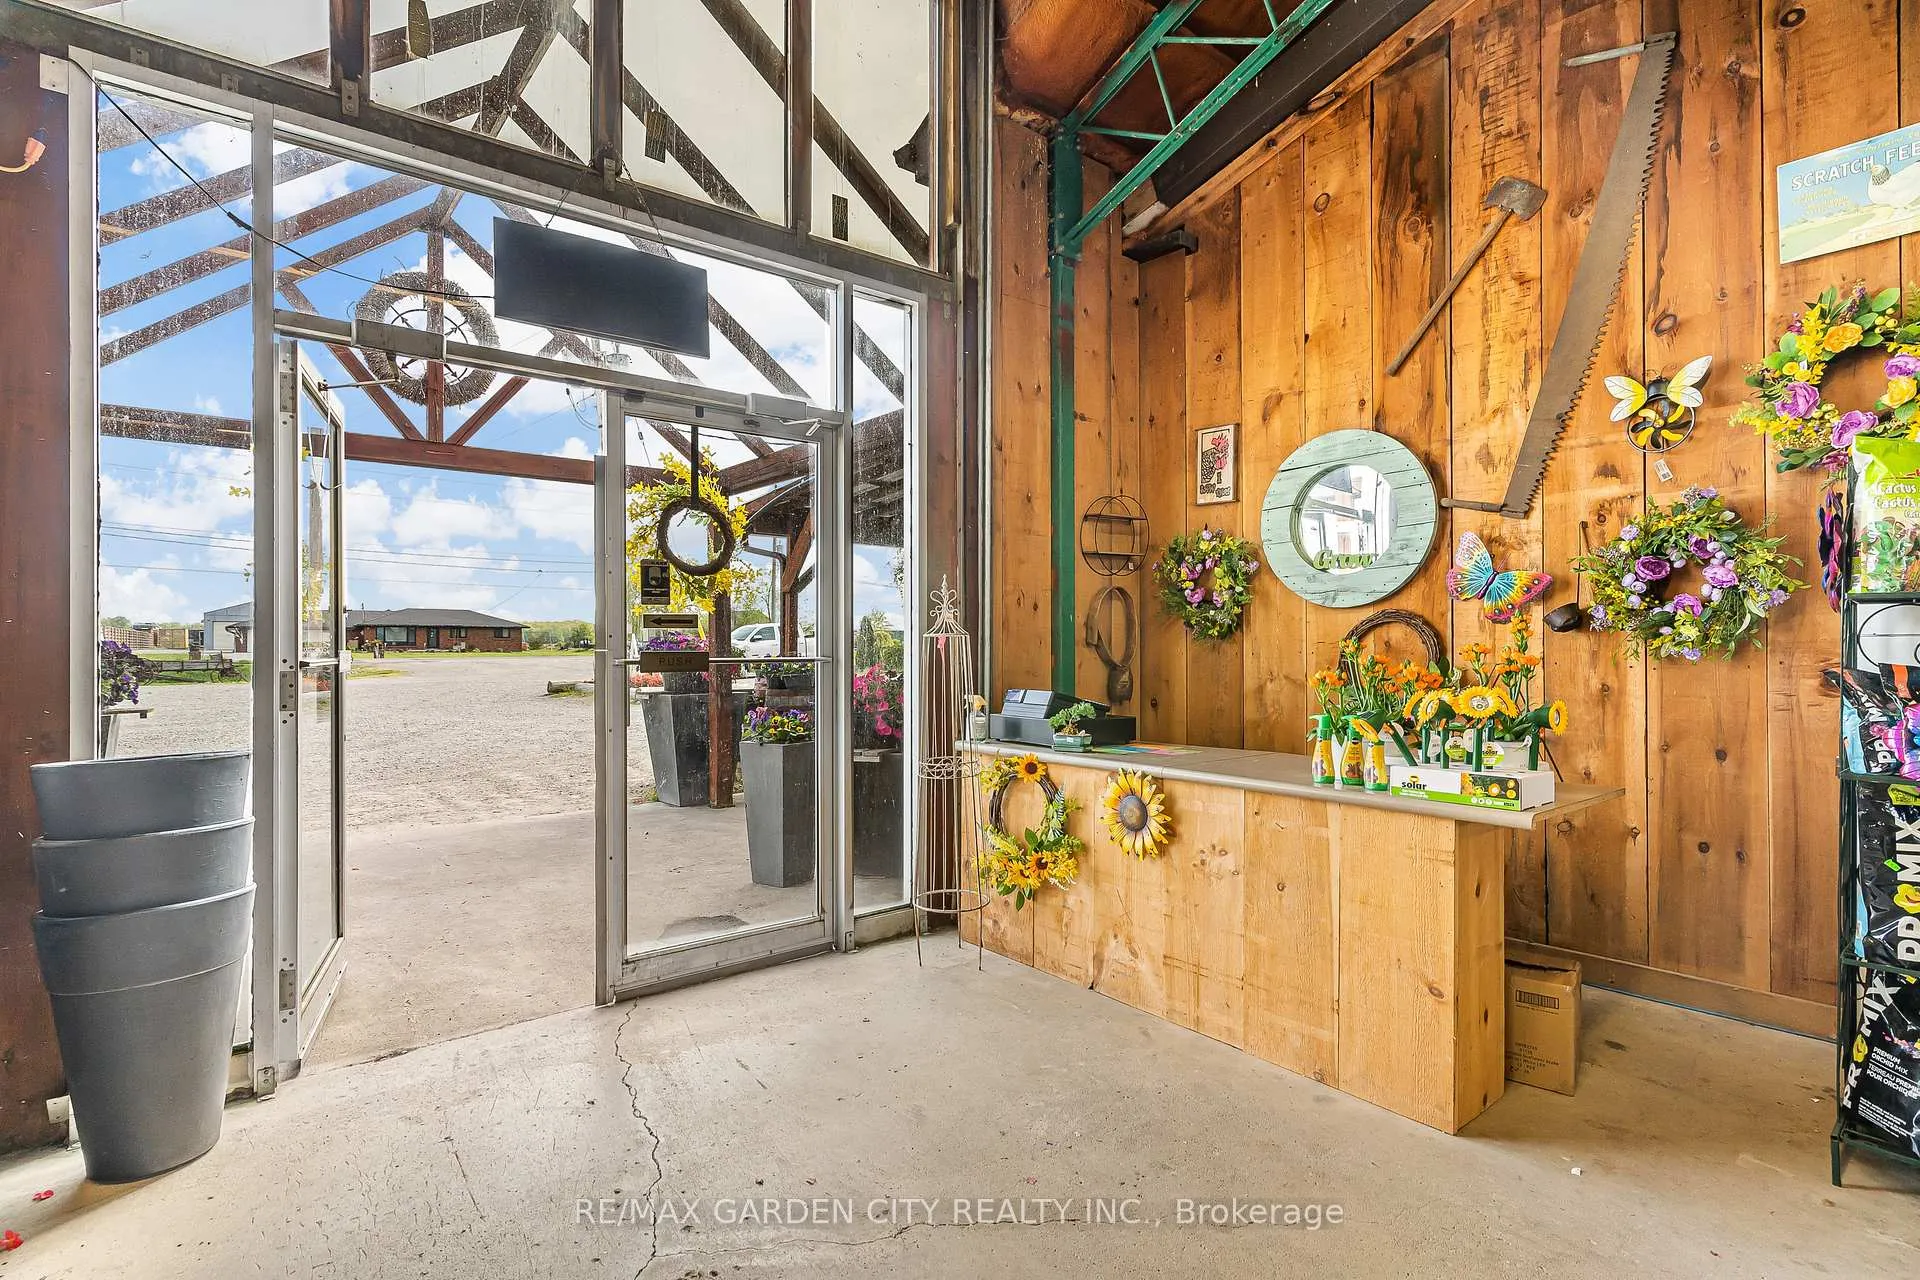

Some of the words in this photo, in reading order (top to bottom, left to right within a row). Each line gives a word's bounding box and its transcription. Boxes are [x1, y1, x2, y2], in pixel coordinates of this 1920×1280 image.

[1791, 155, 1875, 192] SCRATCH
[1876, 481, 1917, 495] Cactus
[1312, 549, 1376, 571] Grow
[658, 656, 693, 666] PUSH
[1401, 780, 1428, 791] solar
[1873, 1046, 1901, 1065] PREMIUM
[1871, 1052, 1895, 1069] ORCHID
[1894, 1064, 1909, 1076] MIX
[1866, 1069, 1883, 1083] POUR
